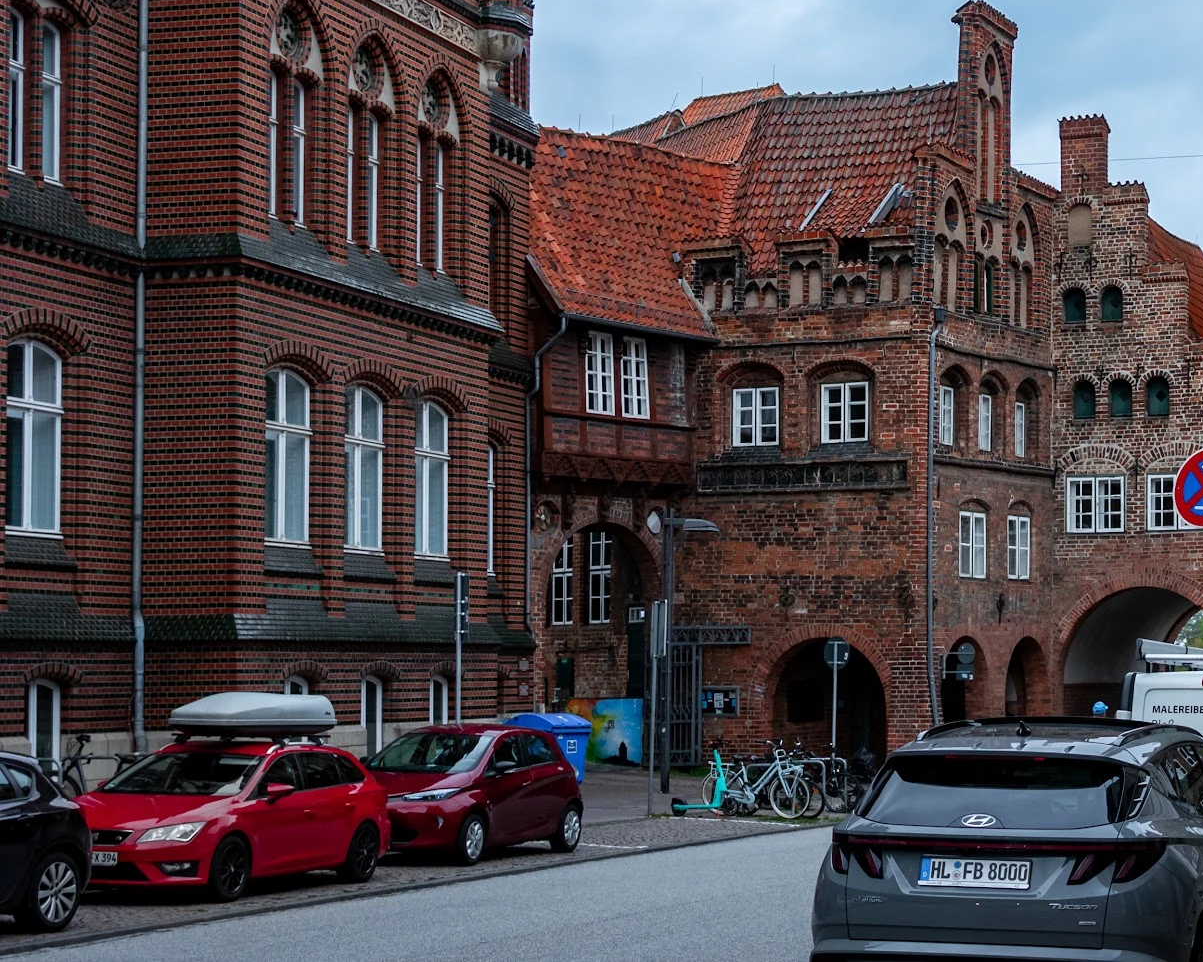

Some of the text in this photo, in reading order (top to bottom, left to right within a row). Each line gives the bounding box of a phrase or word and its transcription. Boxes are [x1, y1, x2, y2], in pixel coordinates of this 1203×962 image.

[101, 852, 116, 863] 394
[930, 861, 1029, 882] HL FB 8000
